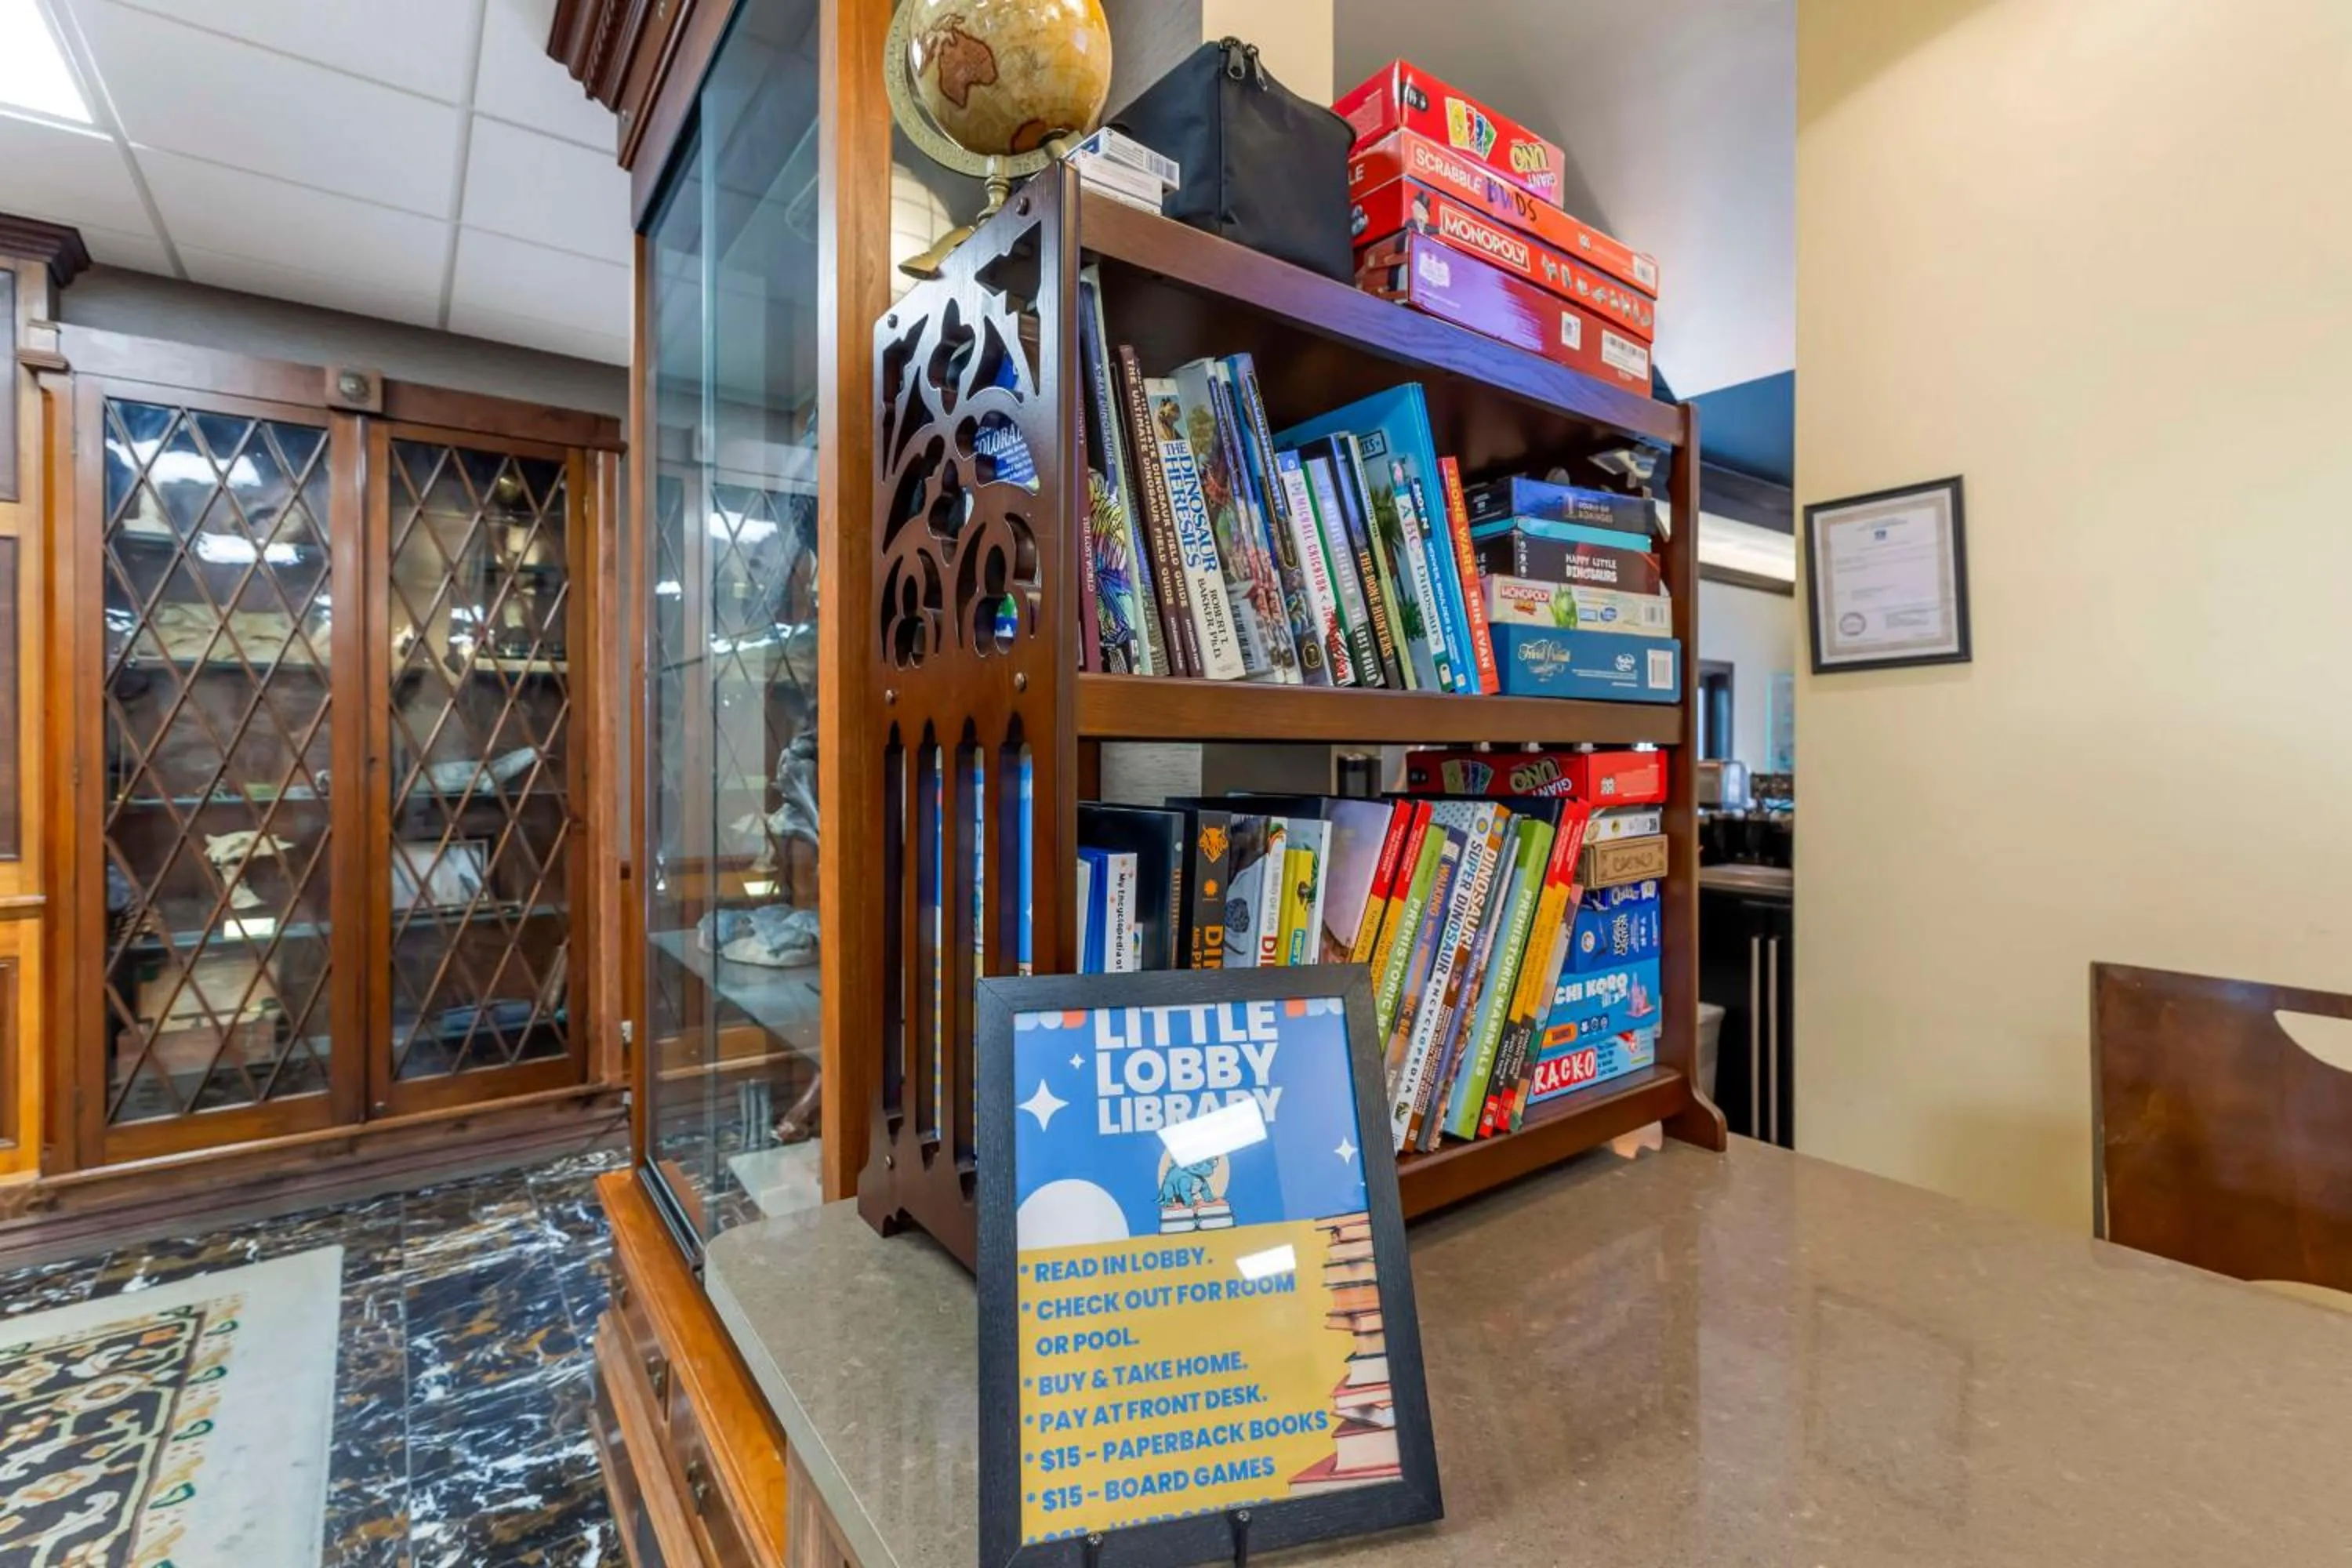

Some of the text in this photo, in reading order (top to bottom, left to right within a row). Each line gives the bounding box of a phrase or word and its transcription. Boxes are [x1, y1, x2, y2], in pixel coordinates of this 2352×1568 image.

[1415, 147, 1482, 194] SCRABBLE
[1444, 216, 1527, 264] MONOPOLY
[1163, 442, 1187, 455] THE
[1127, 358, 1174, 605] THE ULTIMATE DINOSAUR FIELD GUIDE
[1152, 463, 1171, 527] DINOSAUR
[1167, 531, 1179, 565] FIELD
[1174, 570, 1188, 608] GUIDE
[1165, 457, 1201, 568] HERESIES
[1179, 456, 1218, 573] DINOSAUR
[1359, 551, 1373, 575] THE
[1458, 527, 1474, 576] WARS
[1470, 590, 1482, 624] ERIN
[1566, 554, 1617, 569] HAPPY LITTLE
[1566, 564, 1618, 583] DINOSAURS
[1210, 589, 1226, 633] ROBERT
[1366, 575, 1381, 606] BONE
[1501, 586, 1550, 603] MONOPOLY
[1355, 626, 1369, 649] LOST
[1362, 651, 1377, 682] WORLD
[1372, 607, 1394, 659] HUNTERS
[1510, 757, 1561, 793] UNO
[1116, 873, 1126, 888] My
[1428, 864, 1450, 916] WALKING
[1461, 848, 1498, 951] DINOSAUR!
[1116, 890, 1126, 957] Encyclopedia
[1382, 897, 1421, 1010] PREHISTORIC
[1404, 840, 1483, 1094] SUPER DINOSAUR ENCYCLOPEDIA
[1475, 890, 1534, 1077] PREHISTORIC MAMMALS
[1553, 982, 1583, 1005] CHI
[1585, 971, 1628, 998] KORO
[1094, 1000, 1278, 1050] LITTLE
[1096, 1042, 1279, 1096] LOBBY
[1034, 1247, 1214, 1282] READ IN LOBBY.
[1036, 1275, 1297, 1320] CHECK OUT FOR ROOM
[1035, 1327, 1140, 1356] OR POOL.
[1037, 1351, 1248, 1396] BUY & TAKE HOME.
[1039, 1384, 1269, 1433] PAY AT FRONT DESK.
[1040, 1446, 1082, 1472] $15
[1102, 1423, 1246, 1463] PAPERBACK
[1249, 1410, 1329, 1439] BOOKS
[1041, 1485, 1083, 1512] $15
[1105, 1471, 1189, 1503] BOARD
[1193, 1456, 1276, 1488] GAMES
